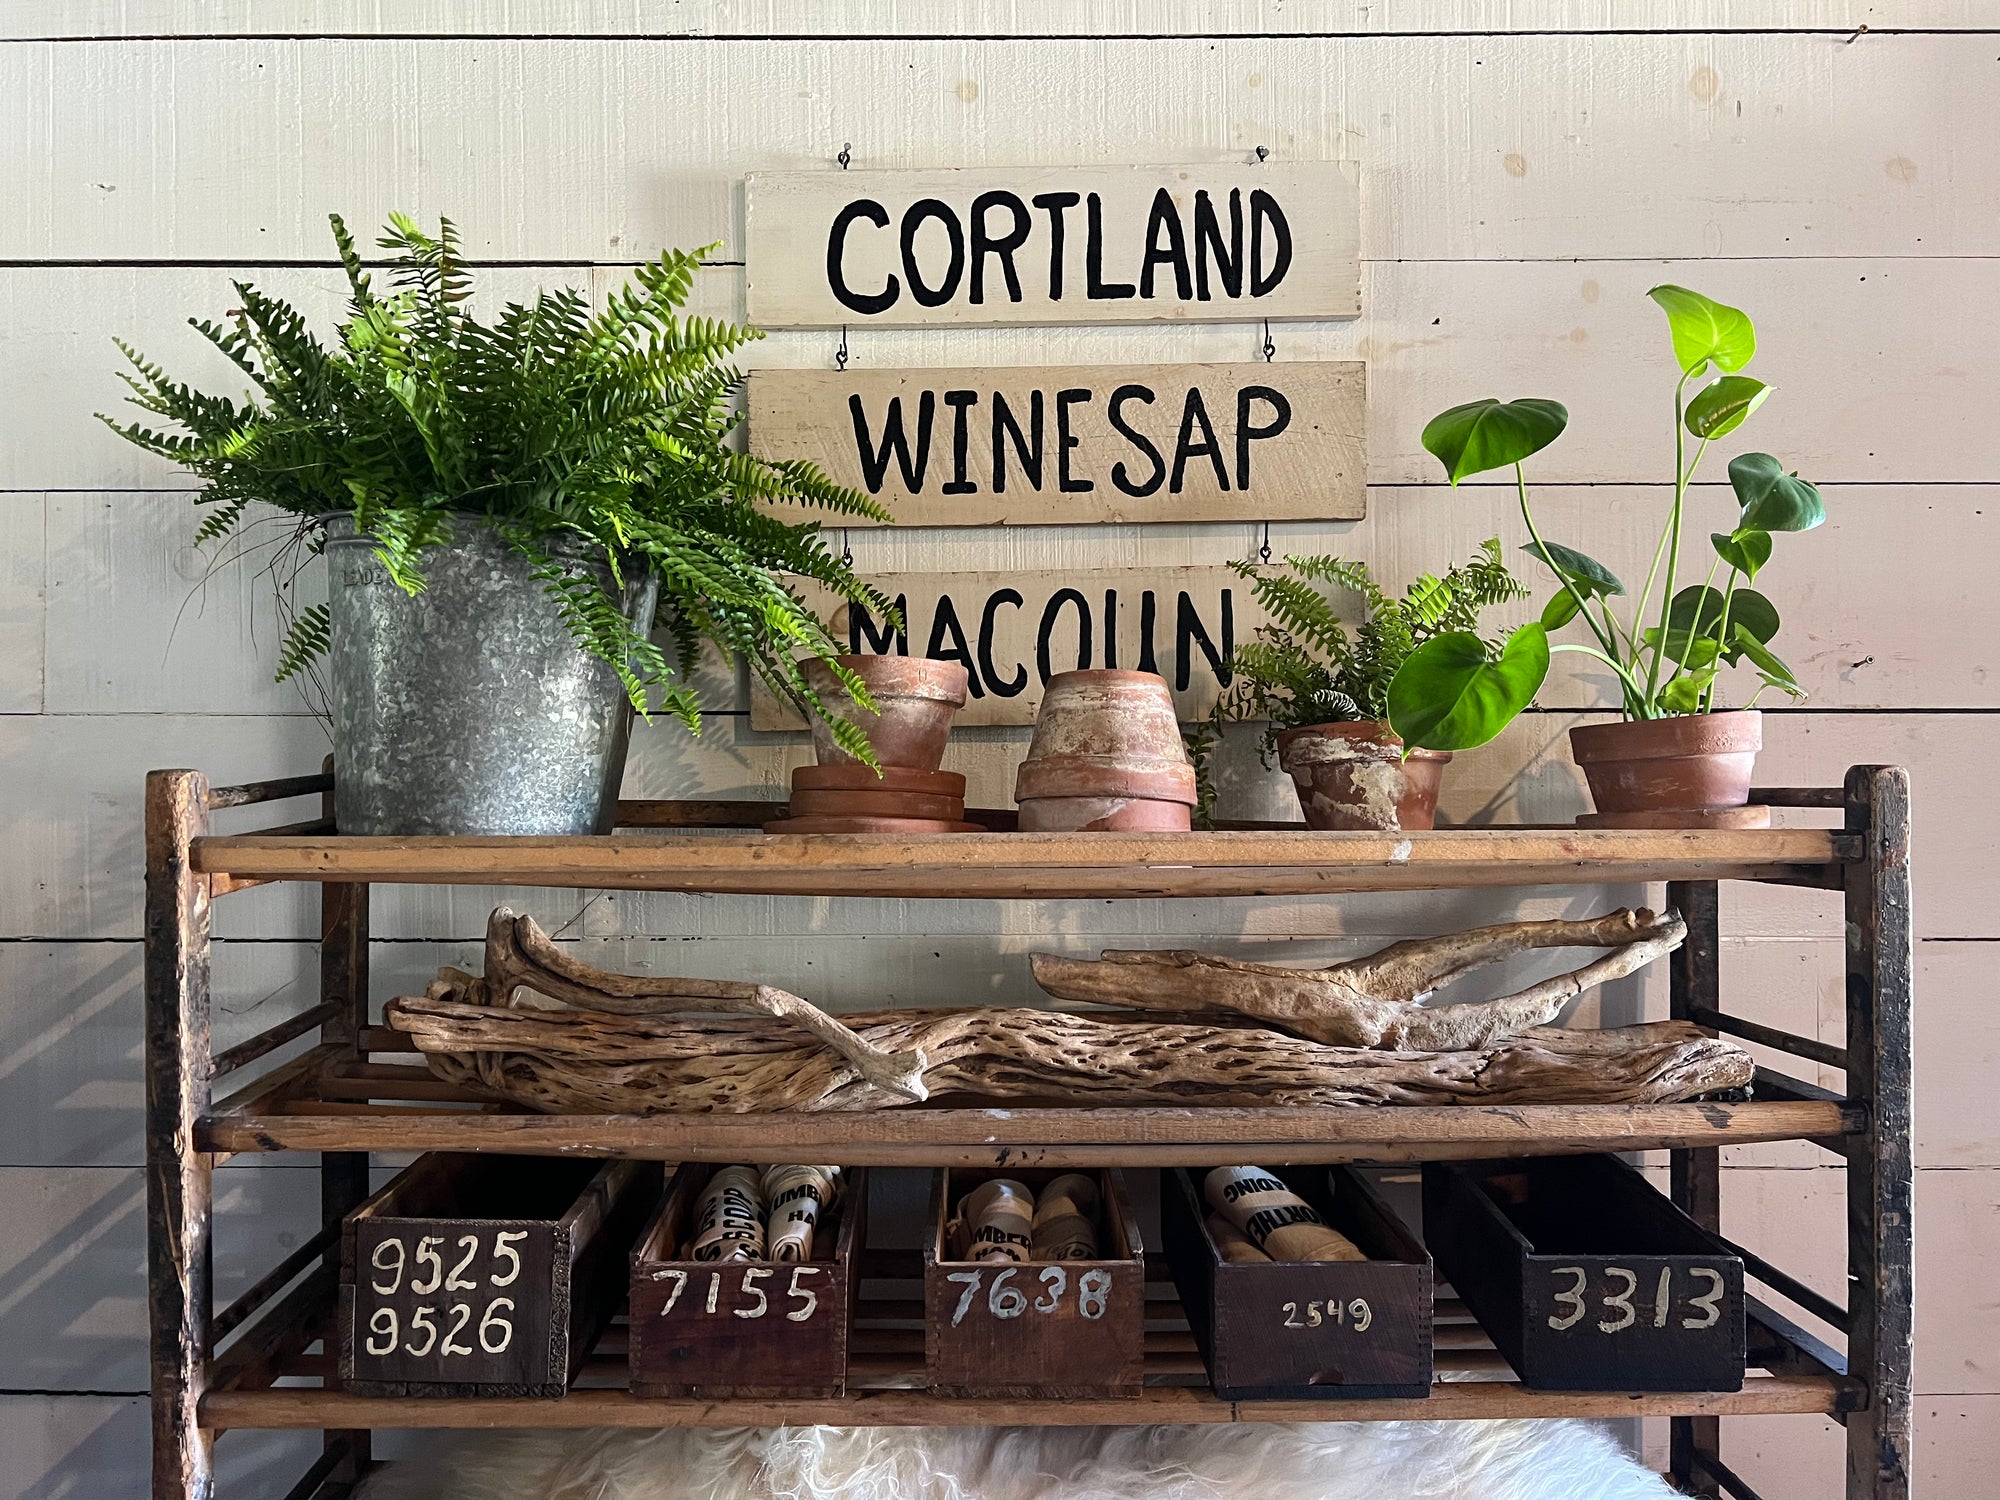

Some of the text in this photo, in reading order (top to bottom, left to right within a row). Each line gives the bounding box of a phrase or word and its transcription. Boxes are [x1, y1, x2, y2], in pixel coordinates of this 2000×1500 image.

[827, 188, 1292, 314] CORTLAND
[849, 385, 1291, 497] WINESAP
[850, 588, 1234, 699] MACOUN
[1246, 1205, 1328, 1247] ORTHE
[372, 1231, 527, 1295] 9525
[653, 1267, 820, 1321] 7155
[367, 1298, 514, 1356] 9526
[947, 1265, 1112, 1327] 7638
[1282, 1298, 1372, 1332] 2549
[1548, 1266, 1724, 1334] 3313
